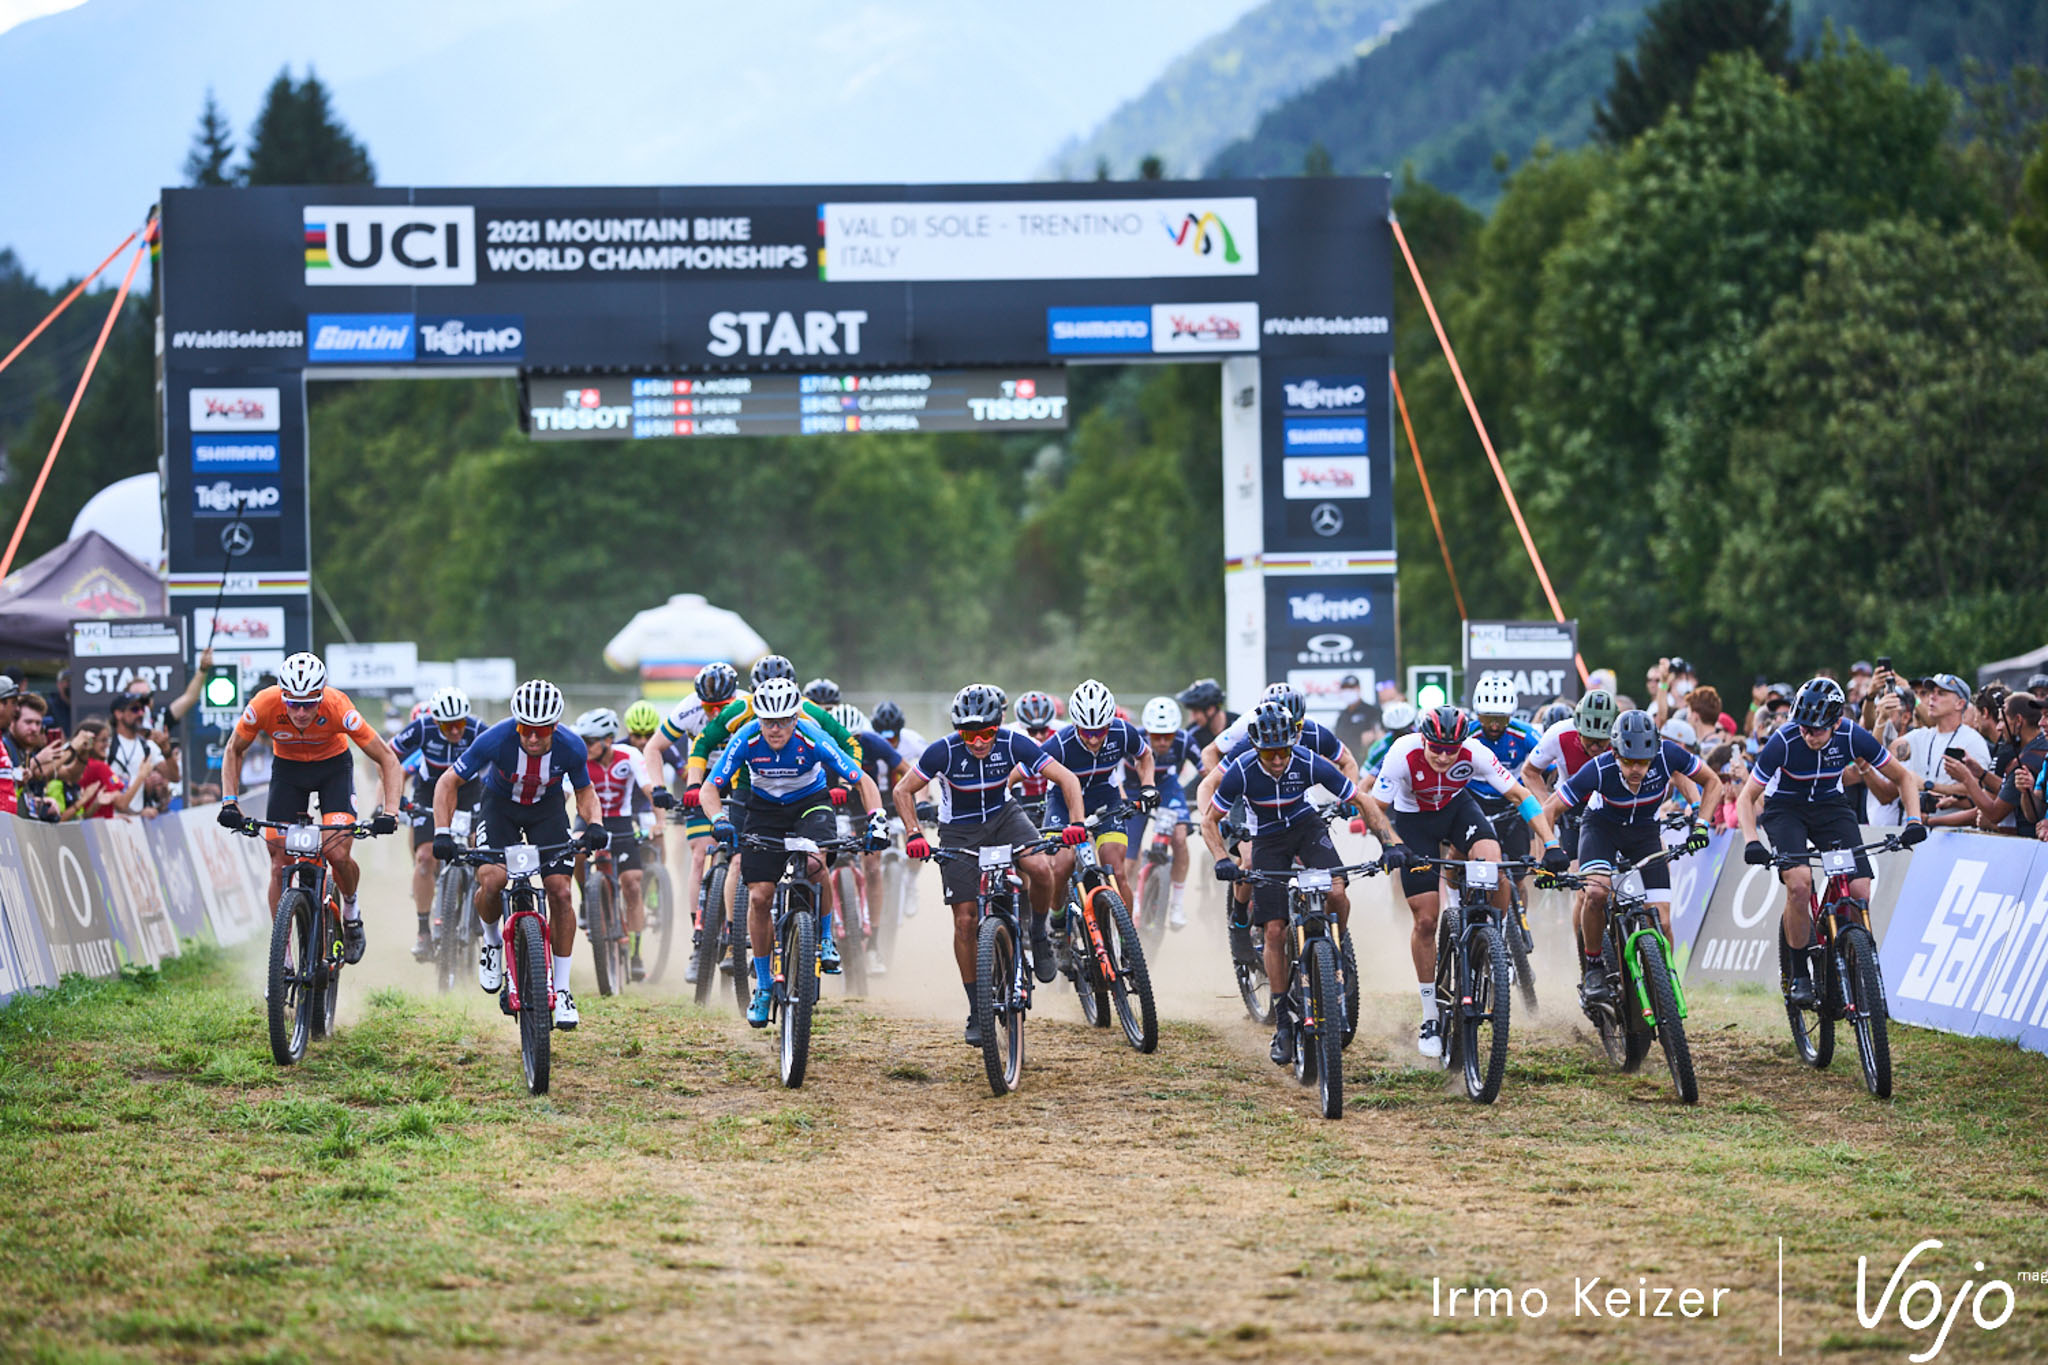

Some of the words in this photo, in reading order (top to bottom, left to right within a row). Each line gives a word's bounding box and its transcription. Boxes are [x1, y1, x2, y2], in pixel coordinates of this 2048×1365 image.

[487, 221, 539, 243] 2021
[546, 219, 688, 242] MOUNTAIN
[694, 218, 751, 240] BIKE
[839, 216, 882, 238] VAL
[892, 216, 917, 237] DI
[925, 214, 991, 236] SOLE
[1019, 213, 1142, 236] TRENTINO
[335, 221, 459, 269] UCI
[840, 246, 899, 268] ITALY
[487, 247, 585, 271] WORLD
[590, 245, 808, 270] CHAMPIONSHIPS
[173, 330, 303, 349] #ValdiSole2021
[315, 325, 410, 350] Santini
[707, 311, 868, 357] START
[531, 406, 632, 430] TISSOT
[967, 396, 1068, 421] TISSOT
[196, 444, 277, 462] SHIMANO
[294, 833, 312, 848] 10
[516, 853, 529, 870] 9
[1476, 865, 1488, 879] 3
[1833, 855, 1844, 866] 8
[1623, 879, 1636, 895] 6
[1701, 938, 1771, 971] OAKLEY
